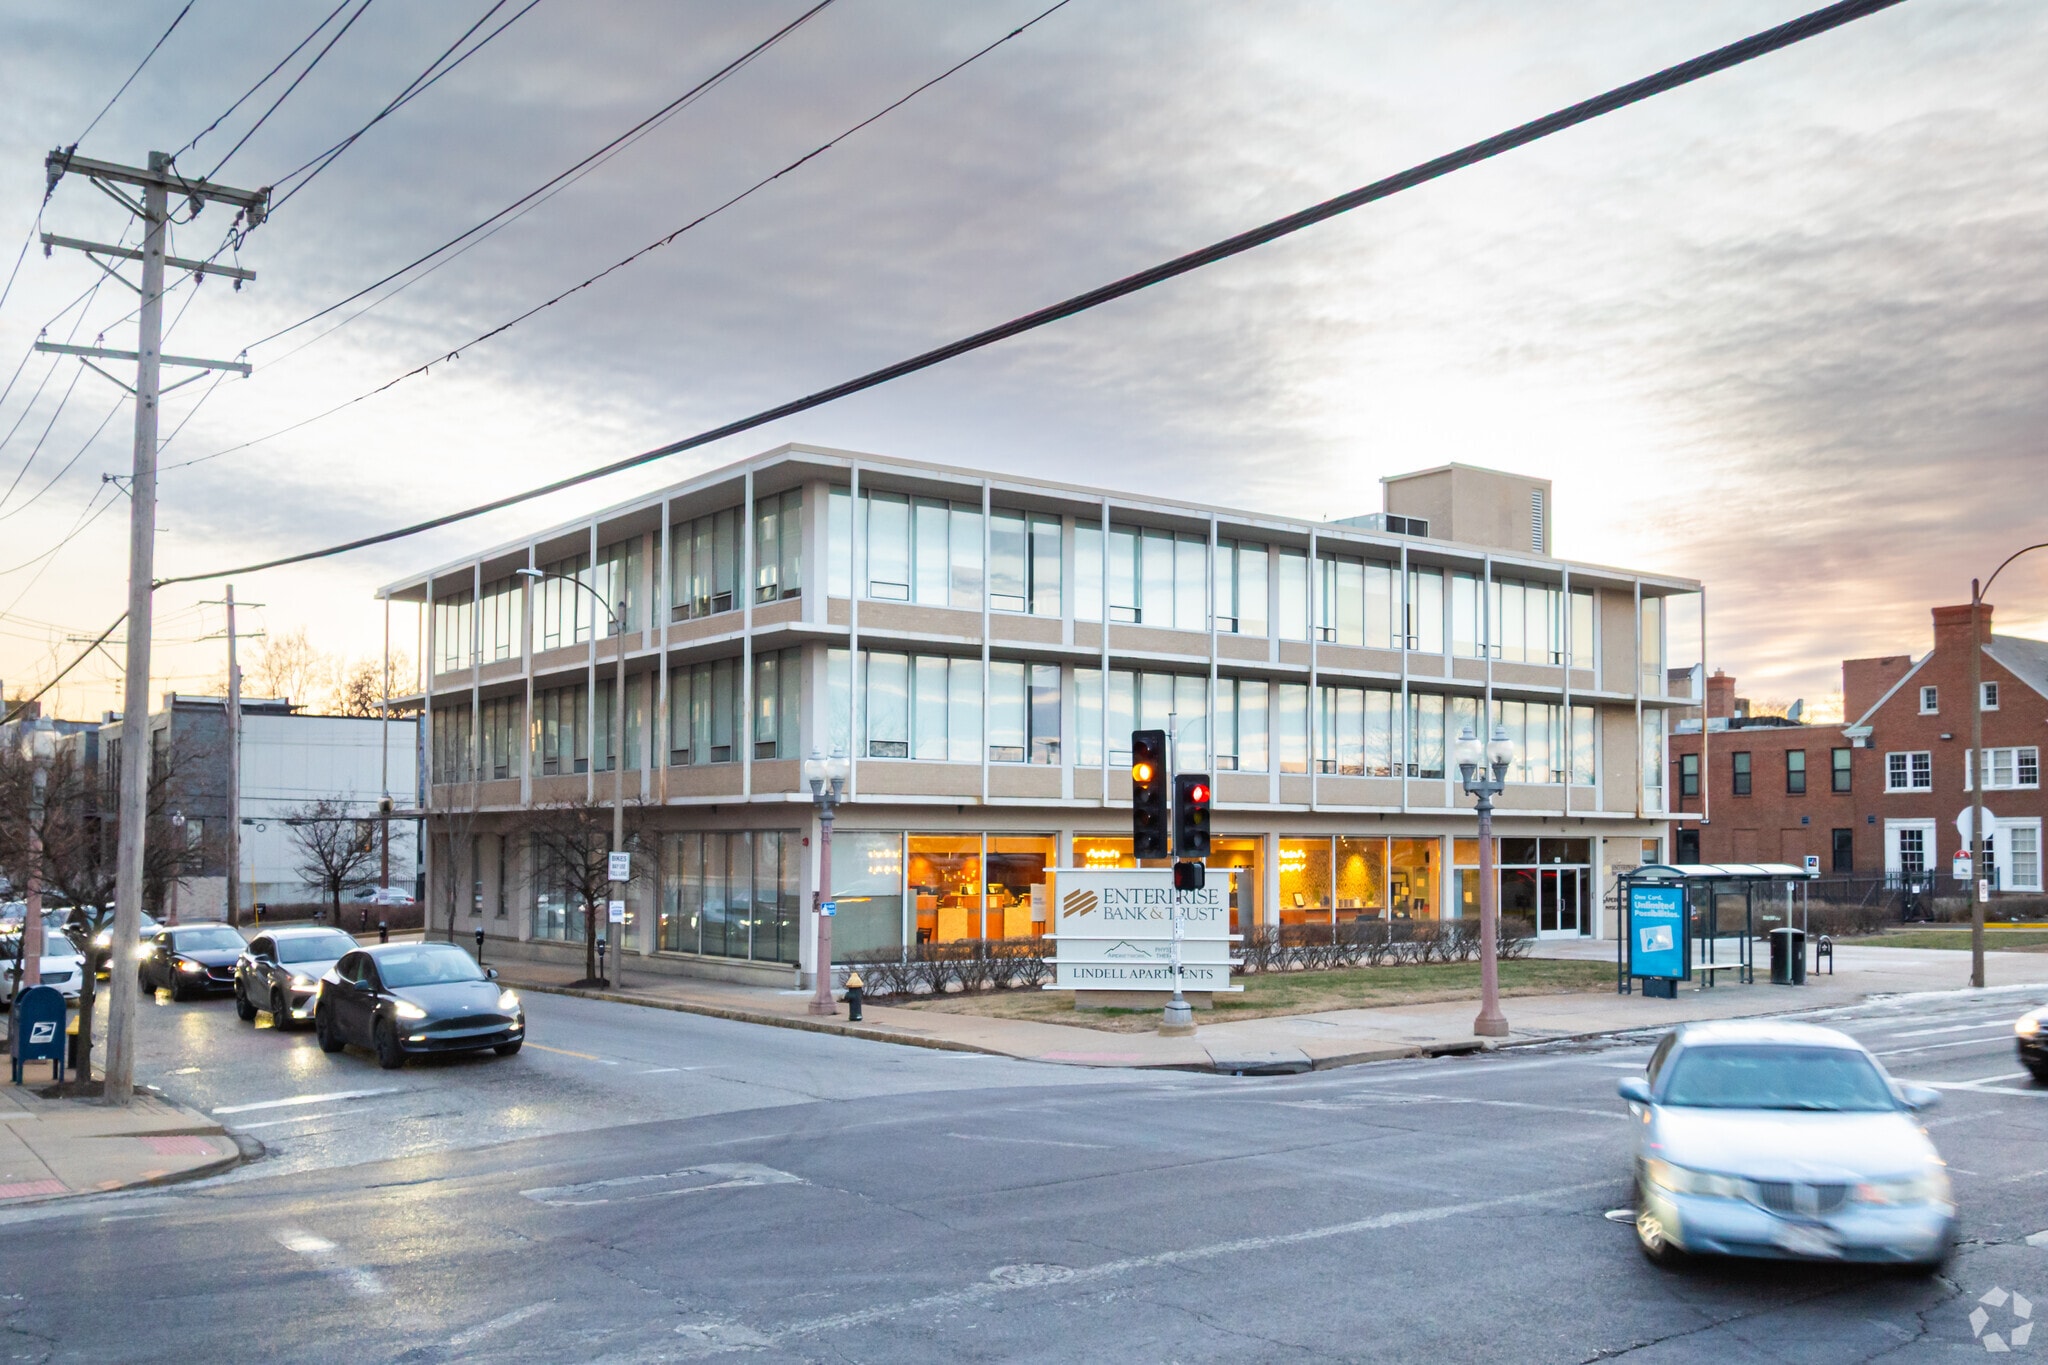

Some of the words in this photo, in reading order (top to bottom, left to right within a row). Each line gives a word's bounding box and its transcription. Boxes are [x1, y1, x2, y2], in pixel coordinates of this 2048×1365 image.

[1634, 901, 1675, 909] Unlimited
[1104, 907, 1147, 920] BANK
[1150, 907, 1164, 919] &
[1165, 907, 1218, 920] TRUST
[1634, 909, 1680, 918] Possibilities.
[1073, 968, 1127, 979] LINDELL
[1129, 968, 1213, 980] APARTENTS
